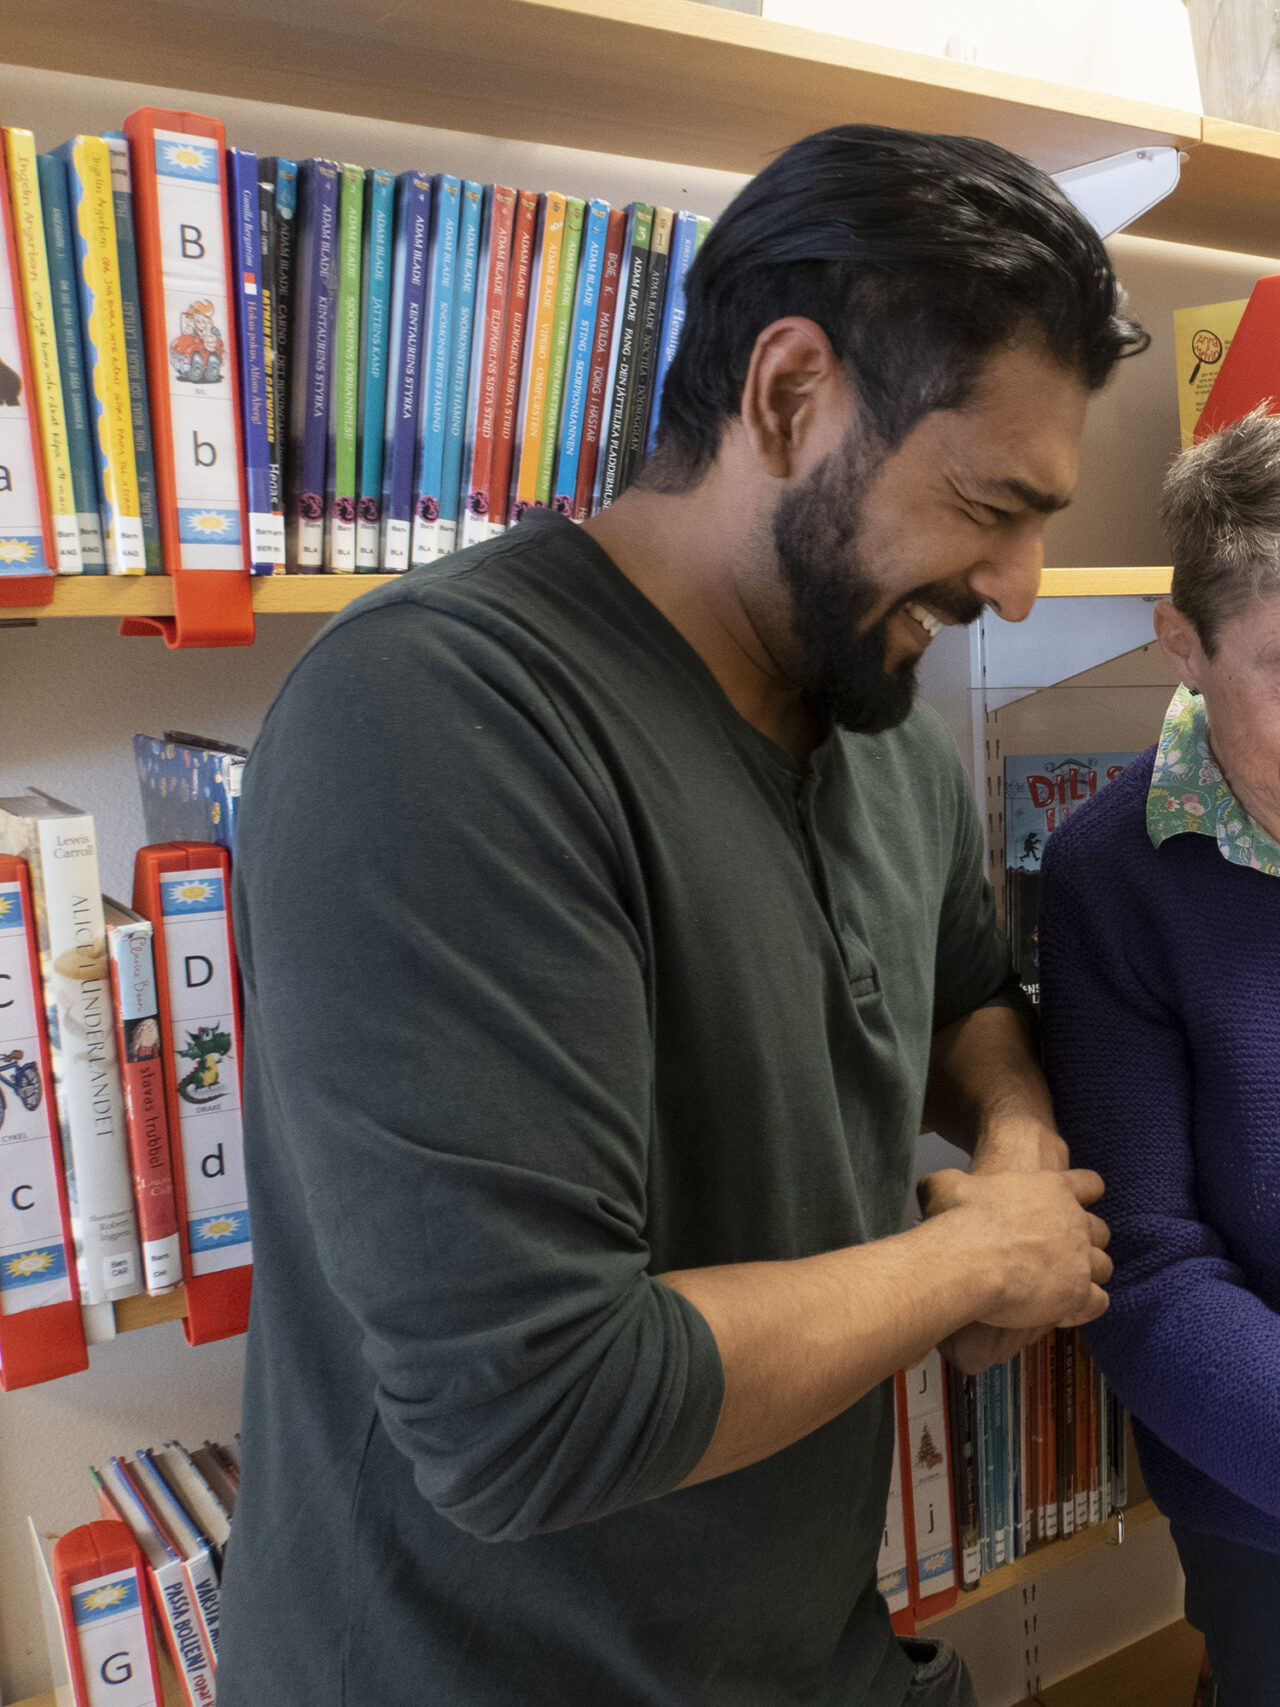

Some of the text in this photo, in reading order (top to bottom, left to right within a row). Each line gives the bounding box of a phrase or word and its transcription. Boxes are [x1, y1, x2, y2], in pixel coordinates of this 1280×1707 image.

[280, 223, 291, 257] ADAM
[348, 207, 359, 240] ADAM
[375, 210, 386, 244] ADAM
[443, 218, 455, 250] ADAM
[464, 224, 476, 256] ADAM
[180, 224, 206, 260] B
[495, 227, 508, 260] ADAM
[519, 231, 531, 264] ADAM
[547, 242, 558, 275] ADAM
[565, 241, 577, 271] ADAM
[347, 243, 358, 278] BLADE
[374, 246, 385, 280] BLADE
[441, 252, 453, 287] BLADE
[462, 258, 474, 292] BLADE
[493, 261, 506, 295] BLADE
[516, 265, 528, 299] BLADE
[543, 275, 556, 309] BLADE
[561, 273, 573, 306] BLADE
[648, 270, 660, 299] ADAM
[247, 301, 257, 331] Hokus
[313, 205, 332, 417] ADAM BLADE KENTAURENS STYRKA
[402, 215, 425, 419] ADAM BLADE KENTAURENS STYRKA
[644, 301, 657, 330] BLADE
[566, 241, 600, 456] ADAM BLADE STING SKORPIONMANNEN
[596, 311, 611, 353] MATILDA
[611, 257, 643, 438] ADAM BLADE FANG DEN JÄTTELIKA
[262, 289, 274, 443] BATMAN CATWOMAN
[371, 346, 381, 378] KAMP
[251, 366, 262, 393] Alfons
[484, 375, 496, 406] SISTA
[505, 377, 516, 406] SISTA
[592, 365, 606, 394] TOKIG
[481, 406, 494, 439] STRID
[502, 408, 514, 440] STRID
[586, 404, 601, 443] HÄSTAR
[193, 431, 218, 467] b
[53, 846, 96, 860] Carroll
[56, 834, 91, 847] Lewis
[70, 895, 94, 951] ALICE
[185, 955, 214, 988] D
[80, 976, 115, 1138] UNDERLANDET
[140, 1066, 165, 1170] stavas trubbel
[201, 1143, 226, 1179] d
[11, 1184, 36, 1211] c
[164, 1581, 190, 1621] PASSA
[100, 1651, 133, 1685] G
